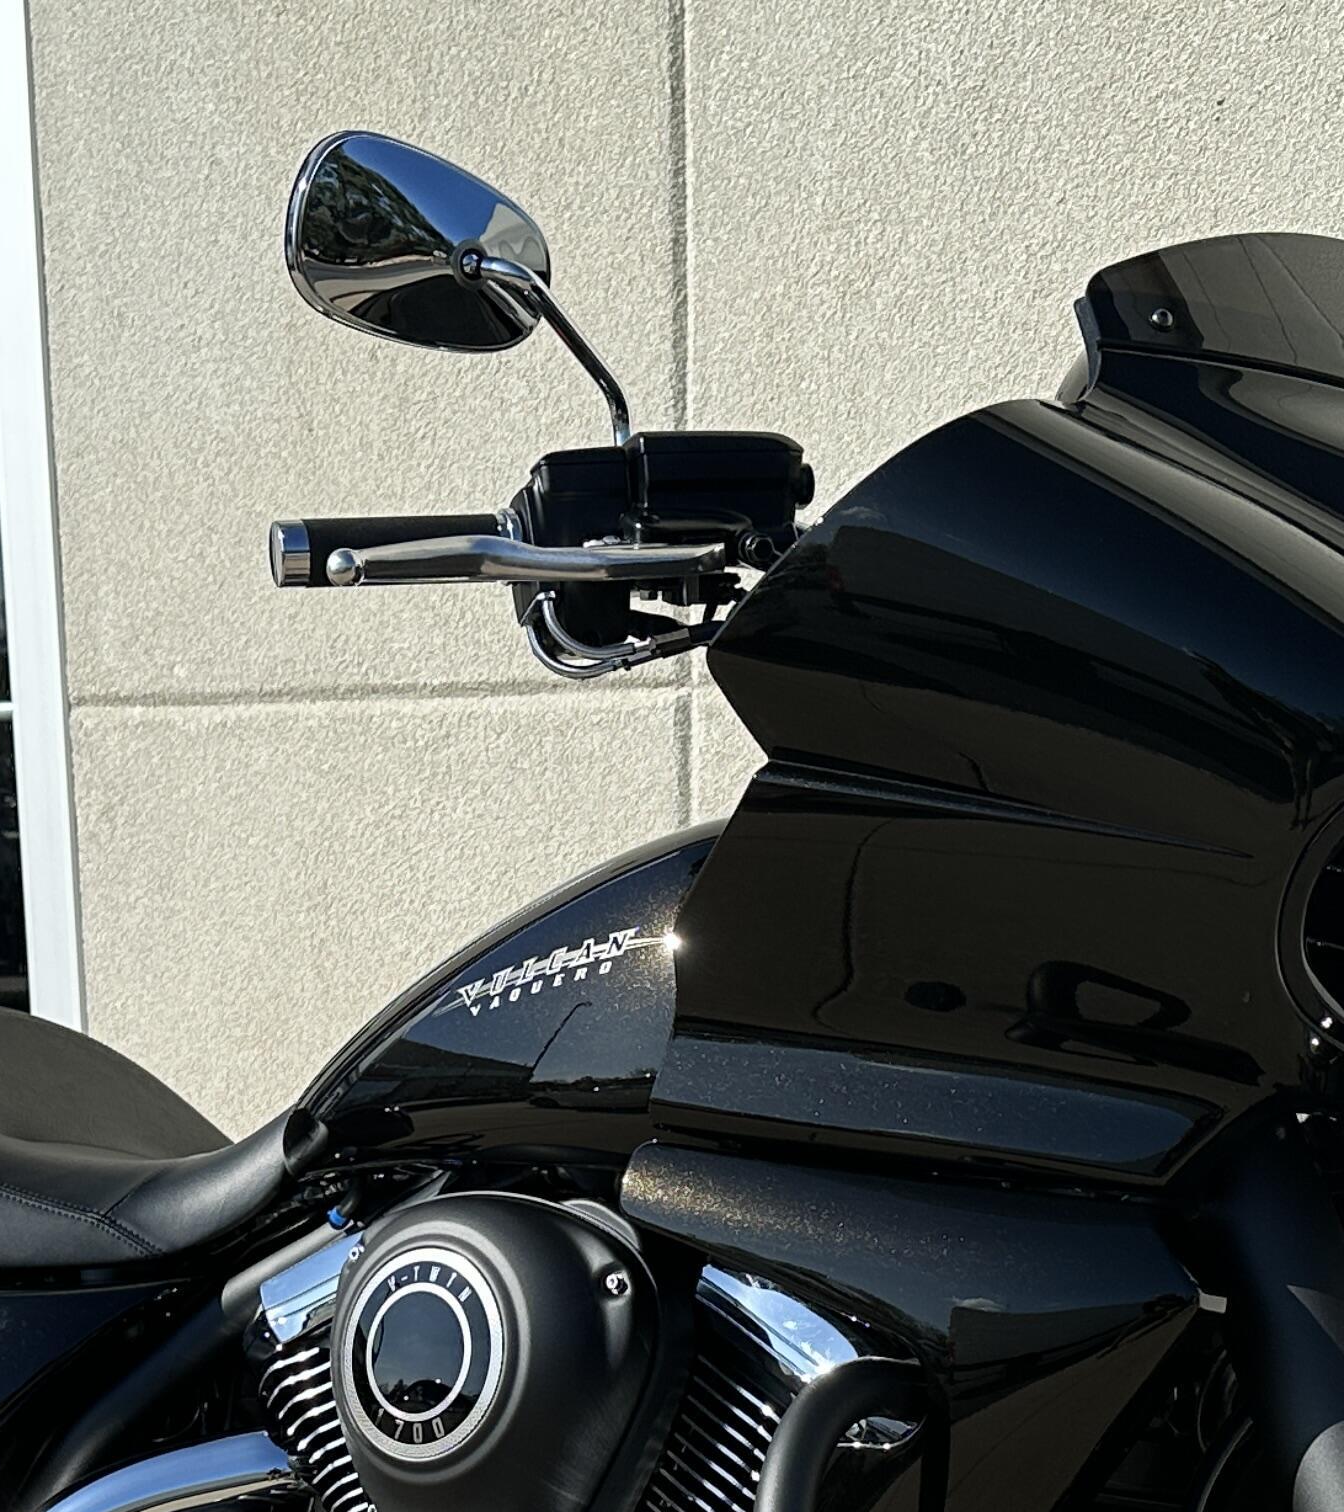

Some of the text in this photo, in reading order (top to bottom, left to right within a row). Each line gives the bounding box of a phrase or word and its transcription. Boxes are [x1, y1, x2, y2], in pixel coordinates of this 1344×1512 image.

[456, 927, 640, 1007] VULCAN
[470, 961, 613, 1016] VAQUERO
[387, 1265, 473, 1302] V-TWIN
[374, 1407, 446, 1443] 1700
